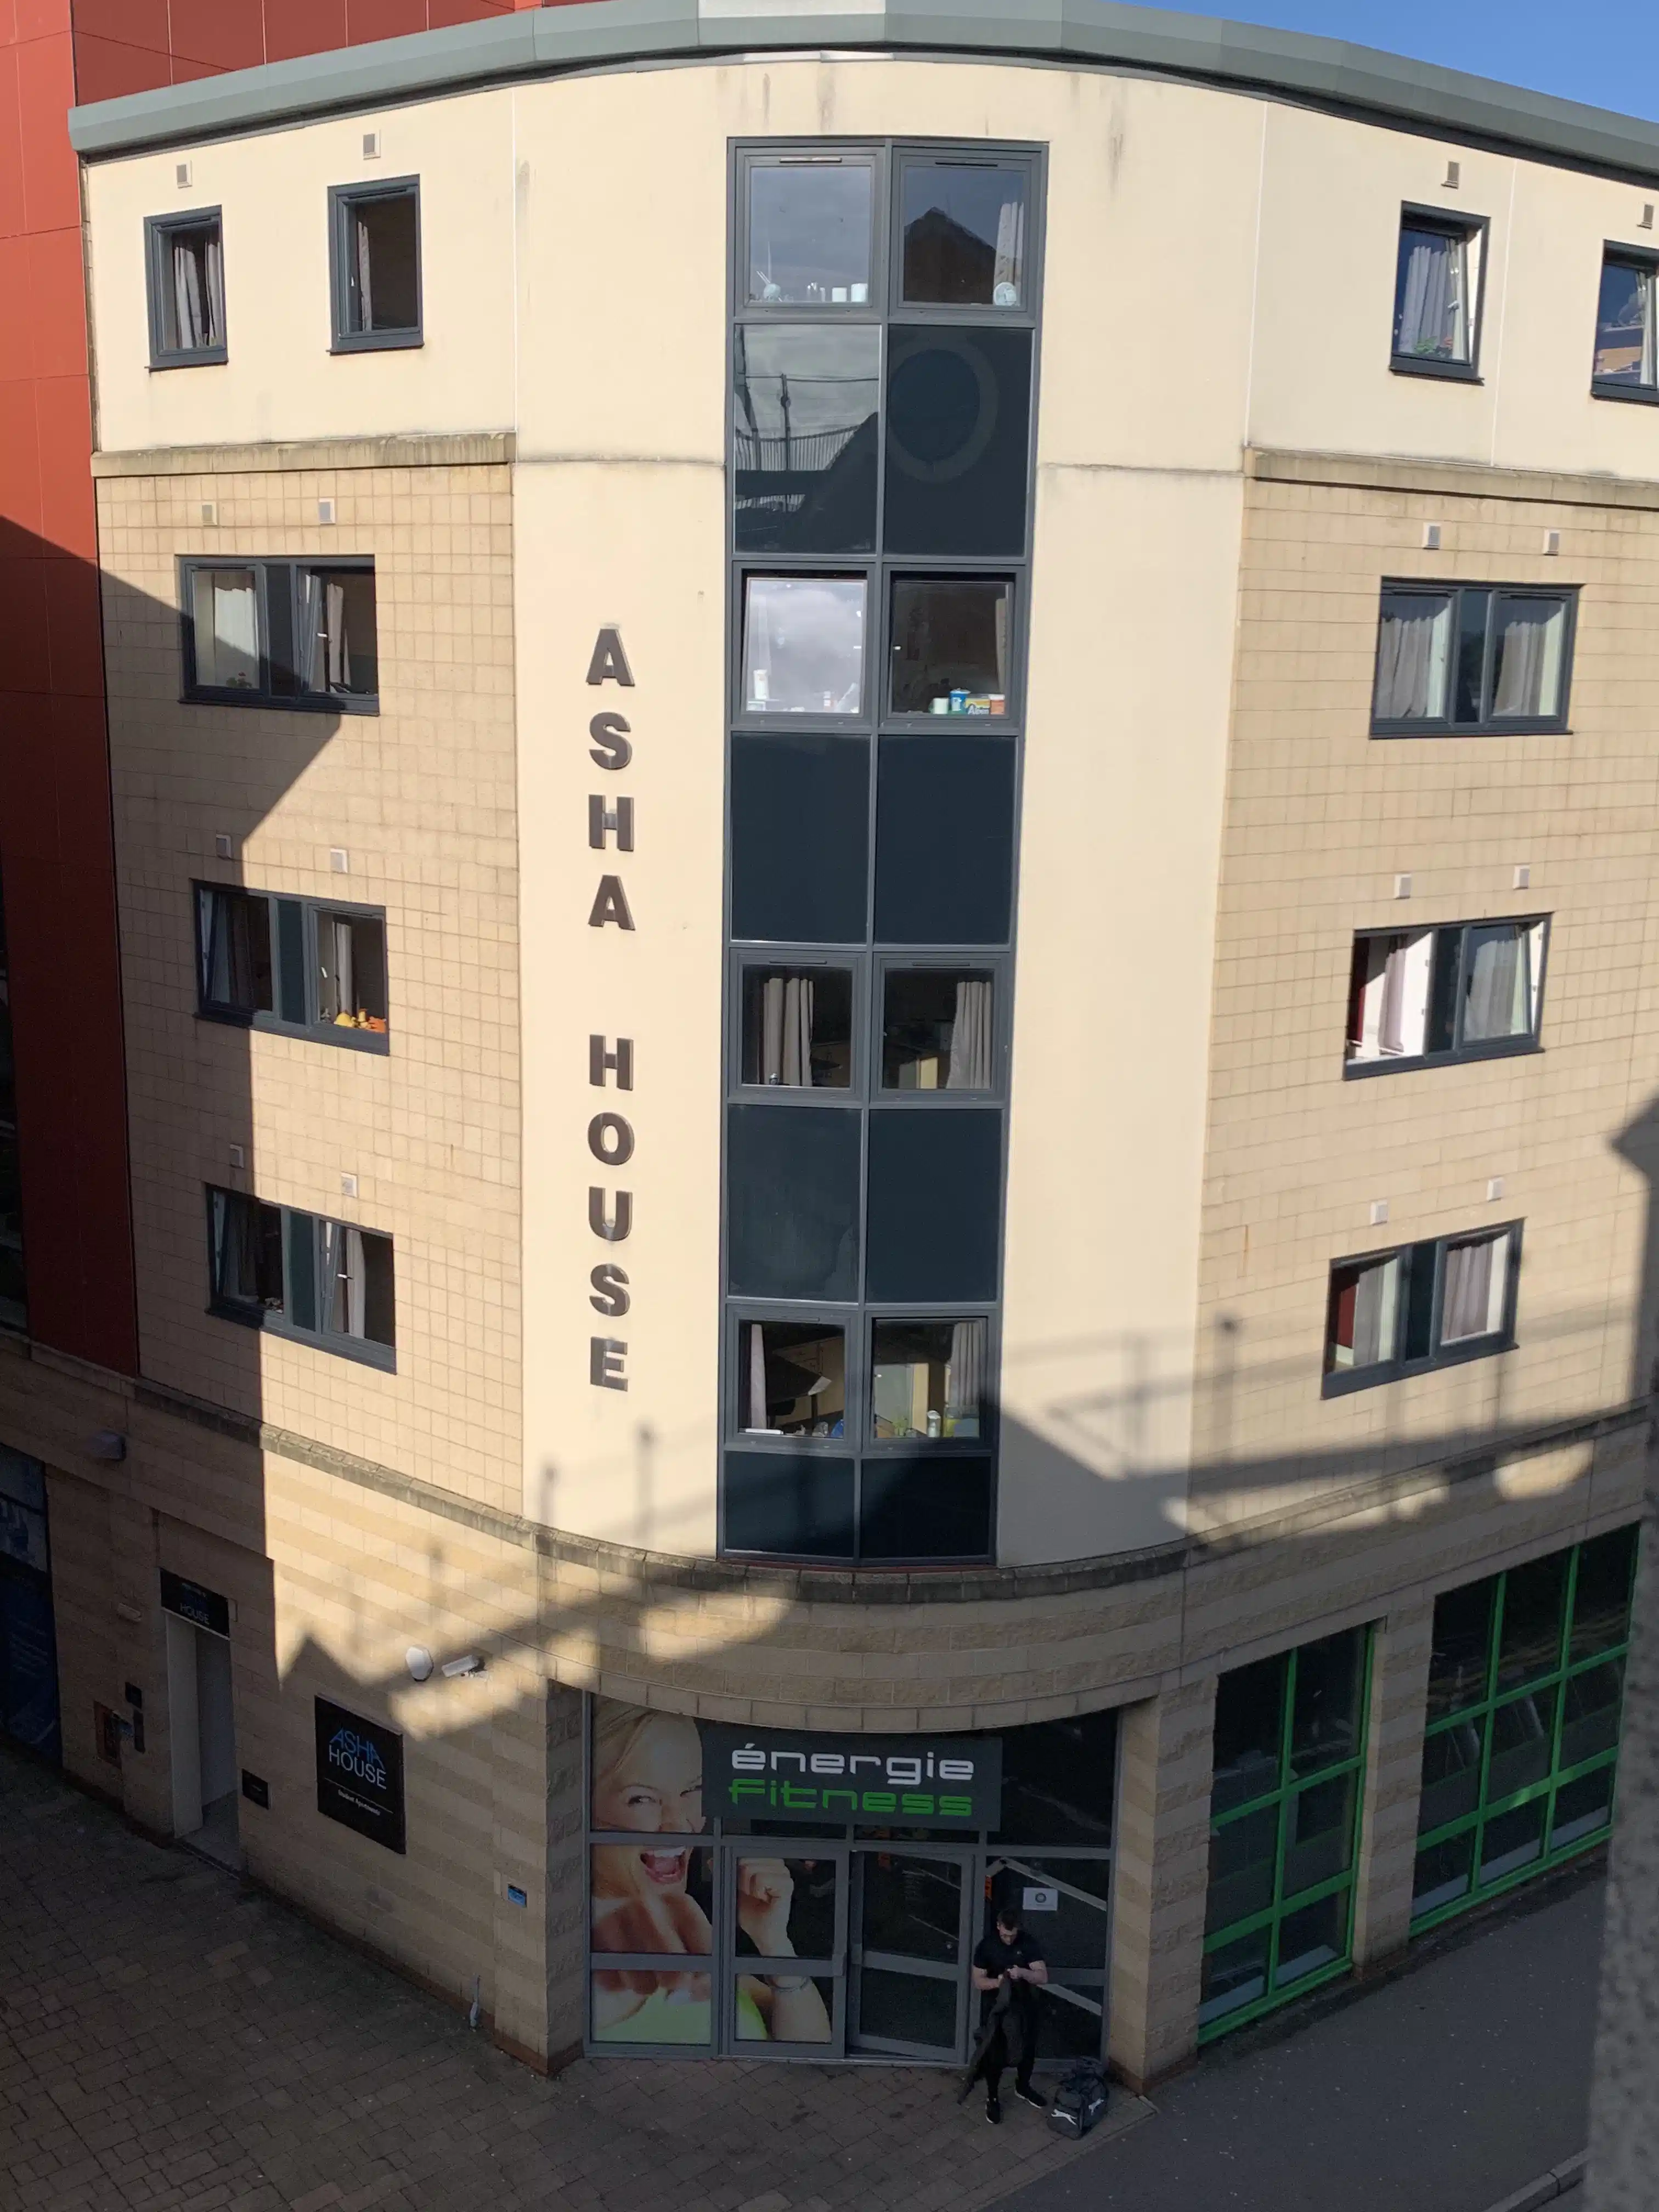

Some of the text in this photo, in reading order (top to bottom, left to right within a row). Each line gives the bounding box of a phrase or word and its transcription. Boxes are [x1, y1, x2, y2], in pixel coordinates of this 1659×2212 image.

[586, 628, 636, 1392] ASHA HOUSE
[180, 1602, 210, 1625] HOUSE
[329, 1727, 386, 1771] ASHA
[329, 1744, 387, 1790] HOUSE
[731, 1743, 974, 1786] énergie
